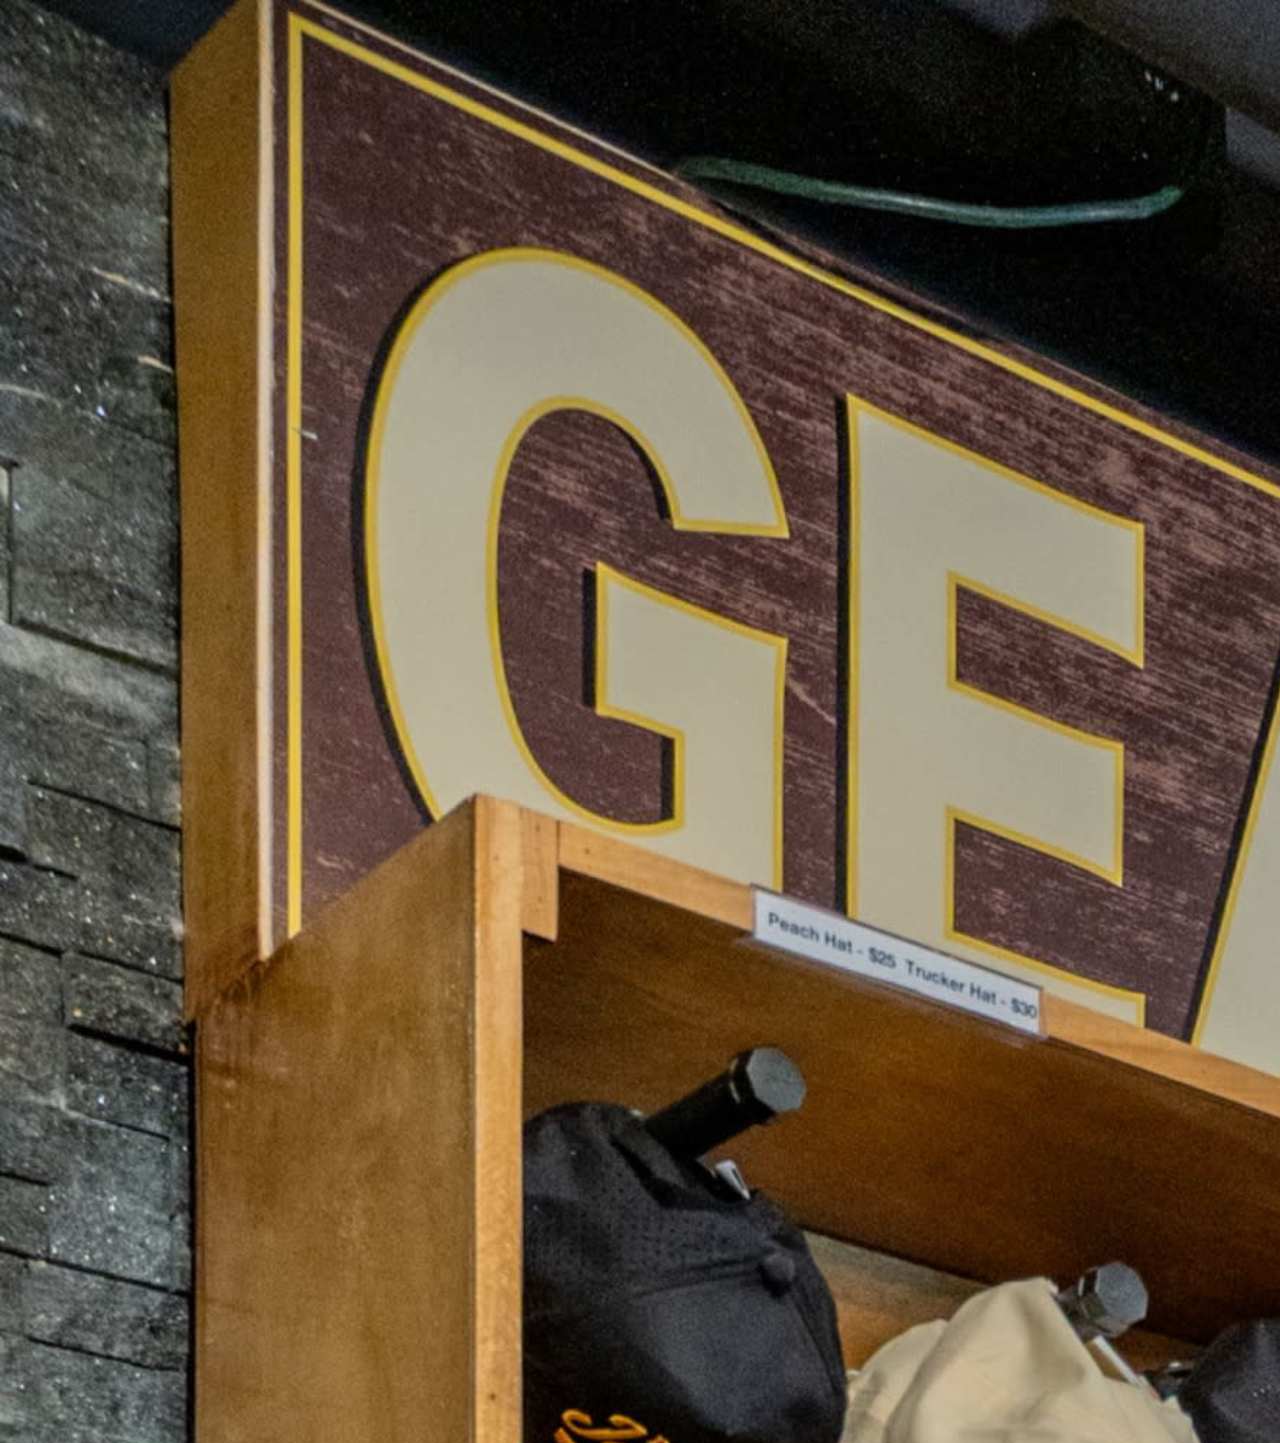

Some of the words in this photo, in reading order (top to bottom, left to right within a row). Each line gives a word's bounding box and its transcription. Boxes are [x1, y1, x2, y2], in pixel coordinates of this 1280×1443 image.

[768, 912, 820, 942] Peach
[825, 933, 853, 954] Hat
[868, 947, 897, 969] $25
[905, 960, 964, 993] Trucker
[969, 982, 998, 1006] Hat
[1011, 997, 1038, 1020] $30
